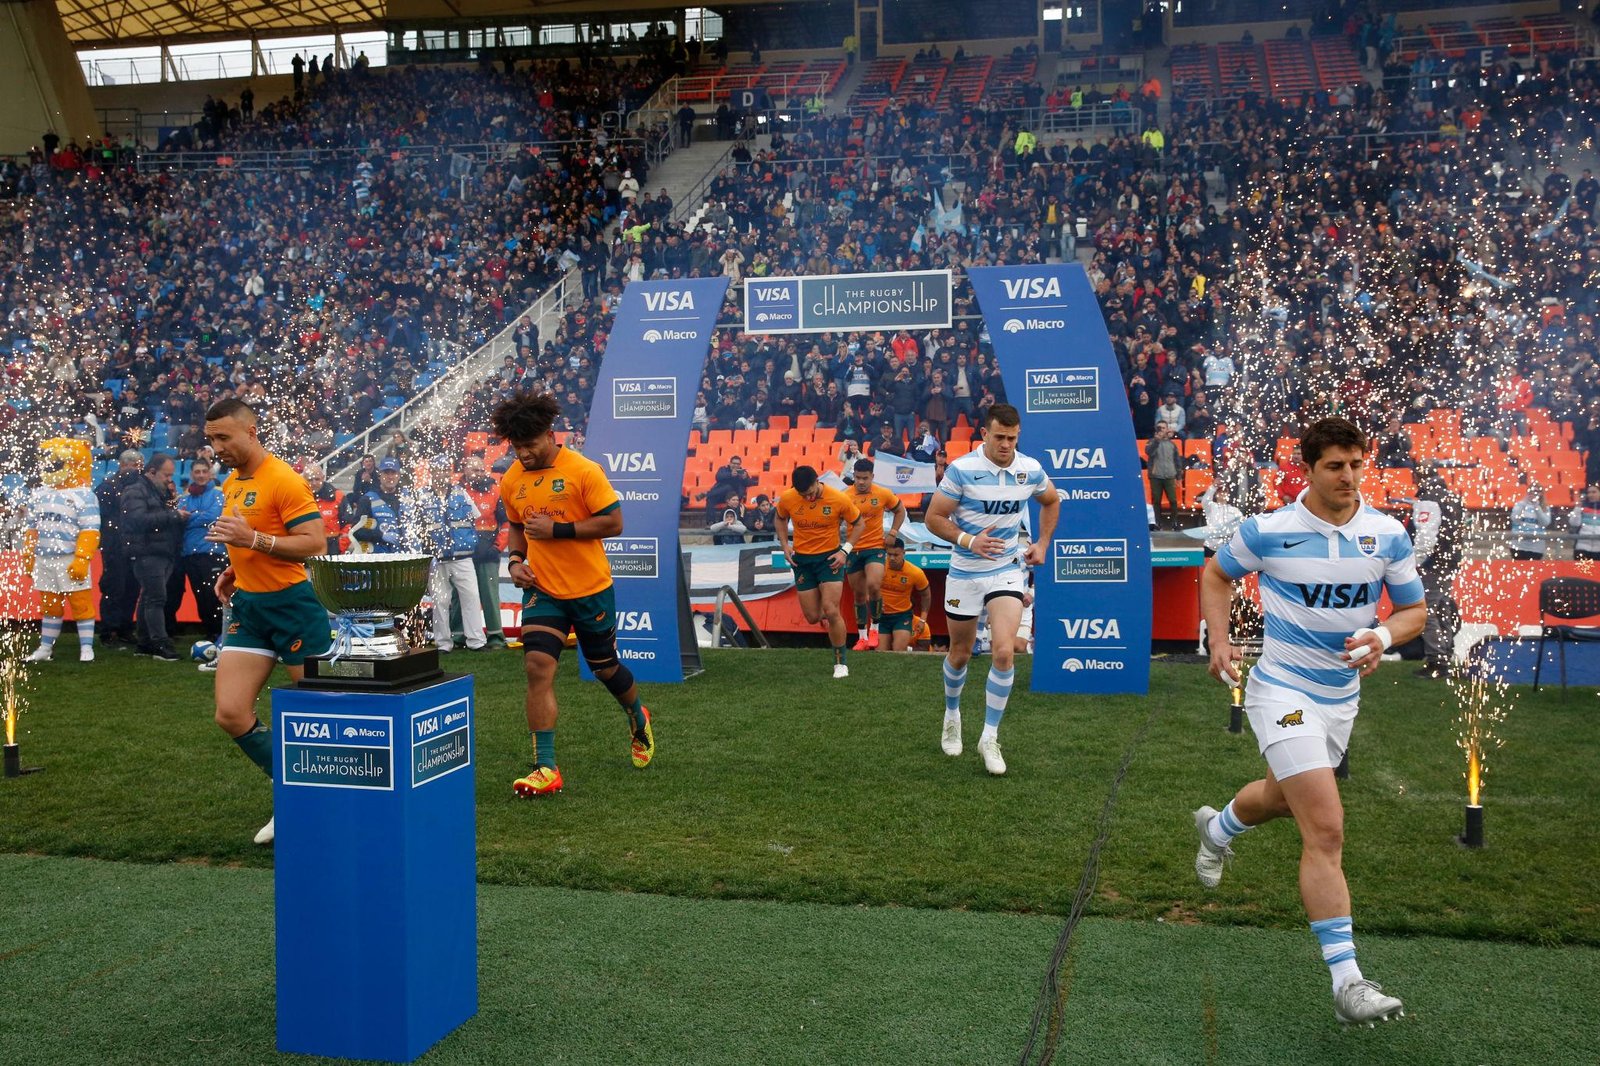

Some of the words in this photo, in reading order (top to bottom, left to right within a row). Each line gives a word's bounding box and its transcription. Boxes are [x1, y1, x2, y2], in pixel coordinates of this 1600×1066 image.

[1481, 50, 1493, 66] E
[743, 92, 754, 107] D
[753, 287, 790, 301] VISA
[845, 290, 865, 298] THE
[870, 289, 904, 297] RUGBY
[1000, 277, 1061, 299] VISA
[640, 291, 694, 311] VISA
[813, 281, 938, 316] CHAMPIONSHIP
[1027, 319, 1064, 330] Macro
[663, 330, 697, 340] Macro
[1032, 374, 1058, 384] VISA
[618, 383, 641, 392] VISA
[1033, 389, 1092, 406] CHAMPIONSHIP
[619, 402, 671, 412] CHAMPIONSHIP
[603, 452, 656, 472] VISA
[1044, 448, 1107, 469] VISA
[626, 491, 659, 501] Macro
[1071, 489, 1110, 500] Macro
[982, 500, 1021, 515] VISA
[603, 542, 624, 552] VISA
[1060, 545, 1086, 554] VISA
[610, 560, 653, 571] AMPIONSHIP
[1061, 560, 1120, 576] CHAMPIONSHIP
[1295, 583, 1369, 608] VISA
[616, 611, 652, 631] ISA
[1058, 618, 1120, 639] VISA
[622, 649, 655, 660] Macro
[1085, 659, 1124, 670] Macro
[290, 722, 331, 739] VISA
[359, 728, 385, 738] Macro
[416, 716, 439, 737] VISA
[452, 711, 466, 722] Macro
[417, 735, 465, 773] CHAMPIONSHIP
[430, 746, 439, 754] THE
[292, 749, 383, 777] CHAMPIONSHIP
